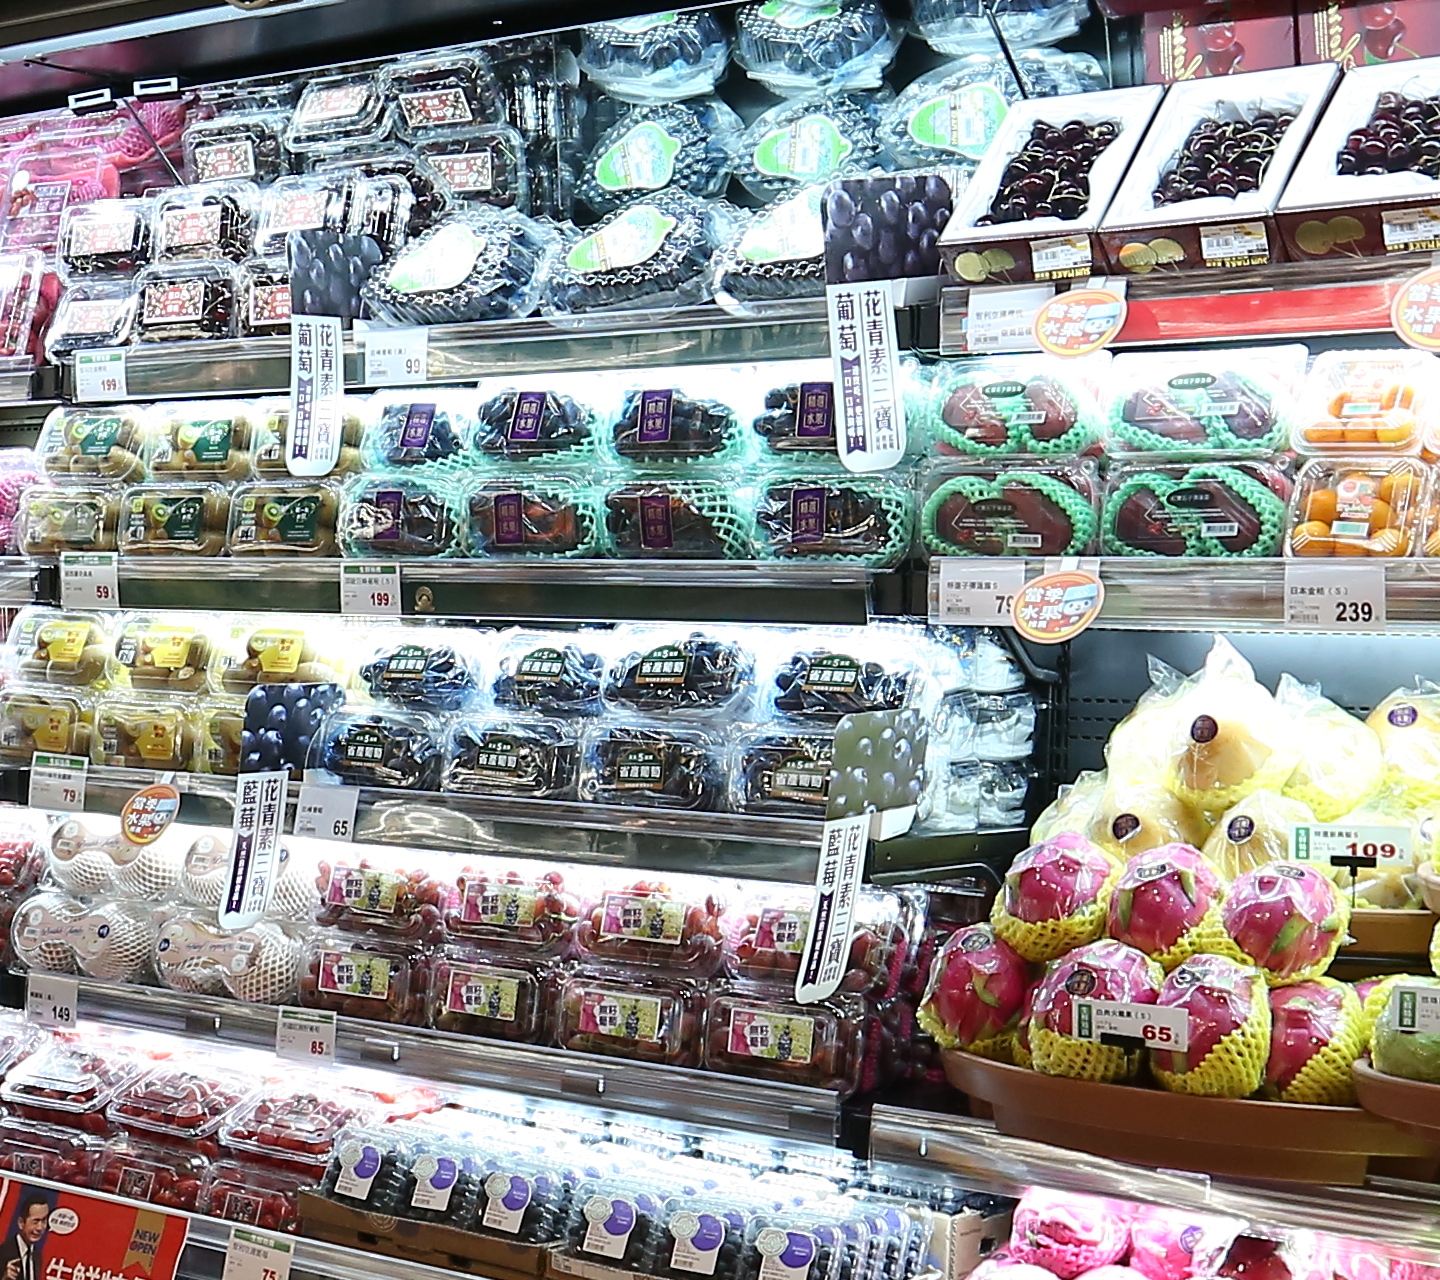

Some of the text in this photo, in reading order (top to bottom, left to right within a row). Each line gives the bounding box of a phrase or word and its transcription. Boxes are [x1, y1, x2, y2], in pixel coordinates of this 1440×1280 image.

[1045, 301, 1086, 322] 當季
[835, 292, 858, 352] 葡萄
[1041, 319, 1083, 340] 水果
[298, 322, 313, 372] 葡萄
[406, 358, 421, 374] 99
[100, 377, 118, 392] 199
[95, 585, 110, 600] 59
[370, 592, 390, 607] 199
[1024, 587, 1064, 604] 當季
[1019, 604, 1062, 621] 水果
[1335, 601, 1373, 623] 239
[388, 656, 424, 674] 省產葡萄
[521, 659, 564, 678] 省產葡萄
[640, 658, 685, 677] 省產葡萄
[809, 666, 858, 687] 省產葡萄
[346, 743, 384, 762] 省產葡萄
[478, 751, 519, 770] 省產葡萄
[619, 761, 663, 781] 省產葡萄
[776, 771, 823, 790] 省產葡萄
[62, 789, 77, 803] 79
[133, 795, 157, 811] 當季
[239, 779, 259, 830] 藍莓
[126, 810, 153, 826] 水果
[333, 820, 348, 836] 65
[821, 826, 841, 889] 藍莓
[1345, 842, 1397, 859] 109
[51, 1005, 71, 1021] 149
[1141, 1023, 1173, 1043] 65
[310, 1041, 325, 1055] 85
[133, 1227, 161, 1244] NEW
[128, 1238, 158, 1256] OPEN
